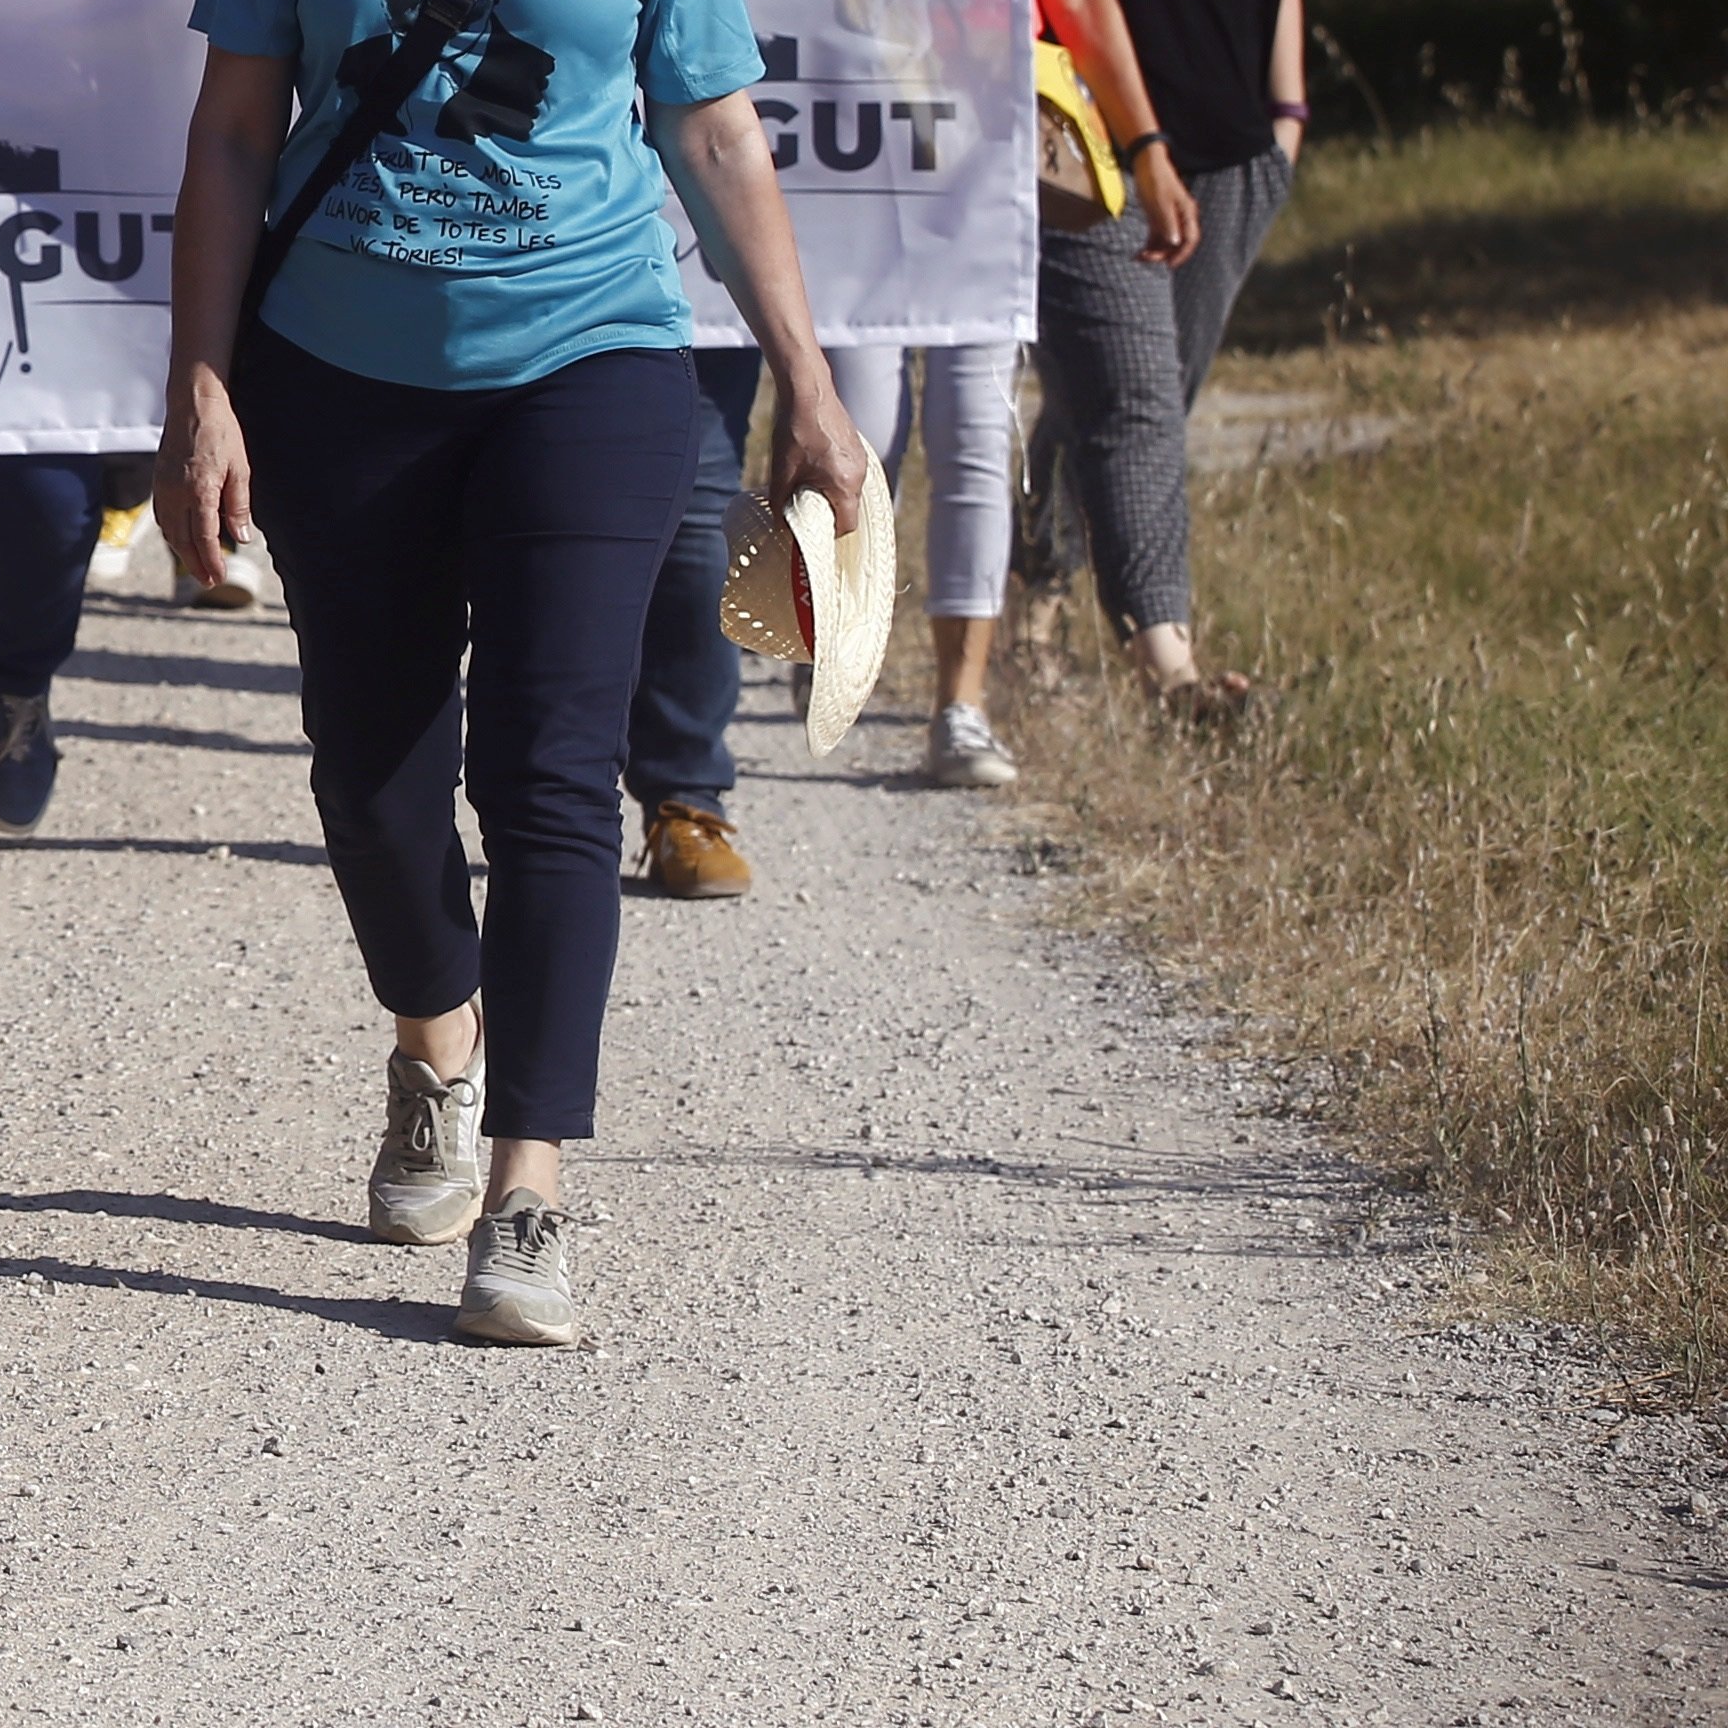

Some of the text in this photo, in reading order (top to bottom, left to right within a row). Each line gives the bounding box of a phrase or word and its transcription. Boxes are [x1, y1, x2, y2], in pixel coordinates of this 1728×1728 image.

[752, 99, 957, 172] GUT
[440, 158, 468, 178] DE
[480, 165, 562, 190] MOLTES
[399, 181, 456, 208] PERÒ
[468, 194, 550, 221] TAMBÉ
[349, 234, 463, 267] VICTÒRIES!
[393, 214, 421, 235] DE
[433, 218, 506, 243] TOTES
[517, 228, 556, 251] LES
